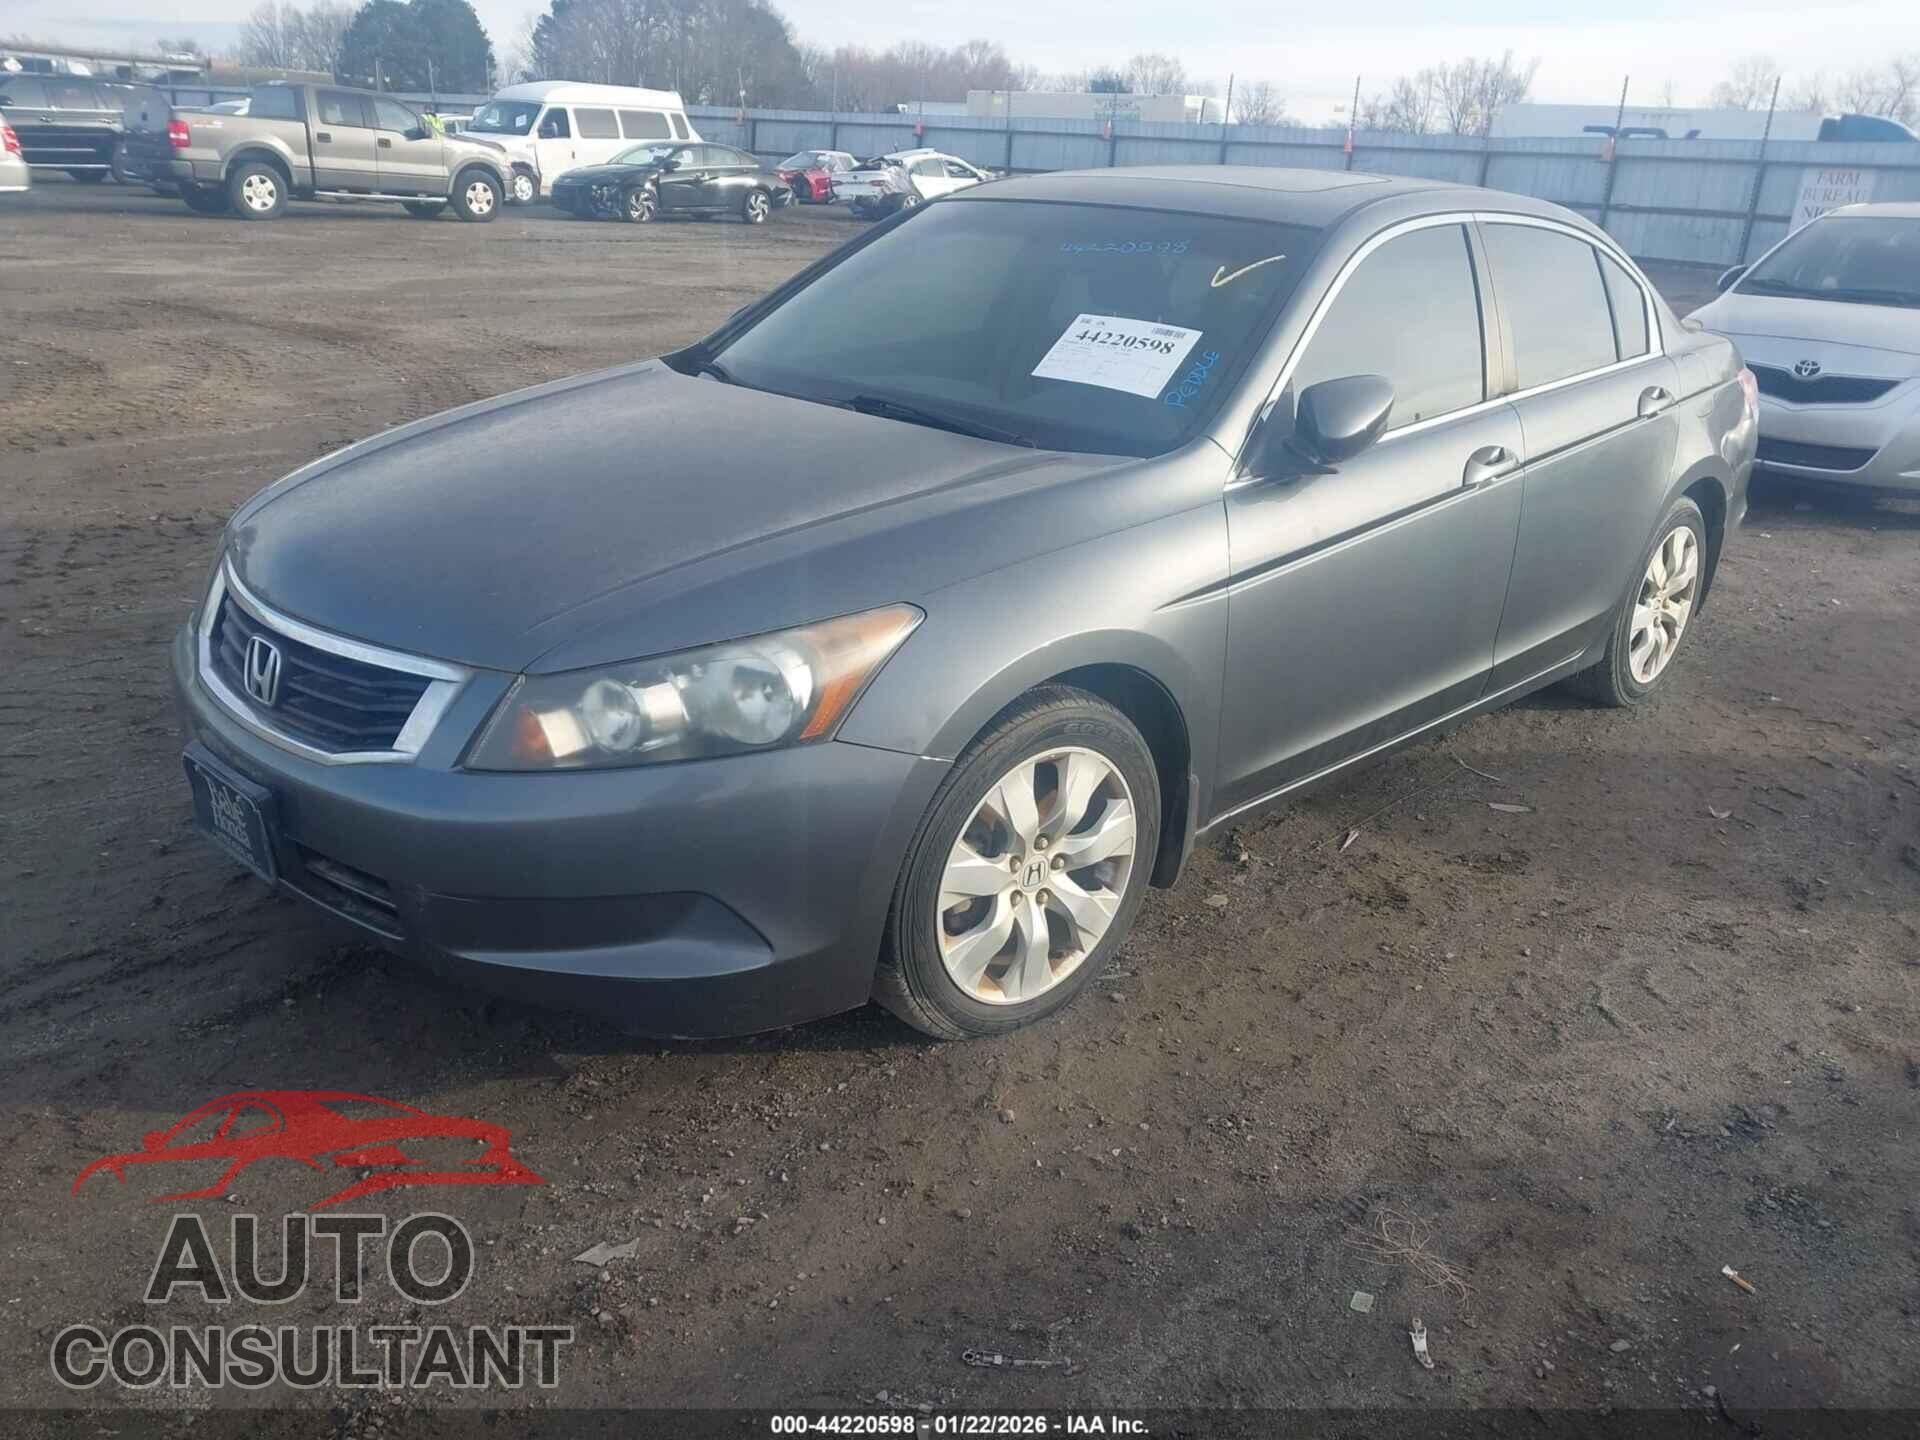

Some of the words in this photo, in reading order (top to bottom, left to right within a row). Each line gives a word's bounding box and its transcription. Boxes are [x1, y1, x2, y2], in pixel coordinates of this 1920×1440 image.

[1816, 172, 1861, 185] FARM
[1802, 187, 1867, 203] BUREAU
[1075, 329, 1176, 354] 44220598
